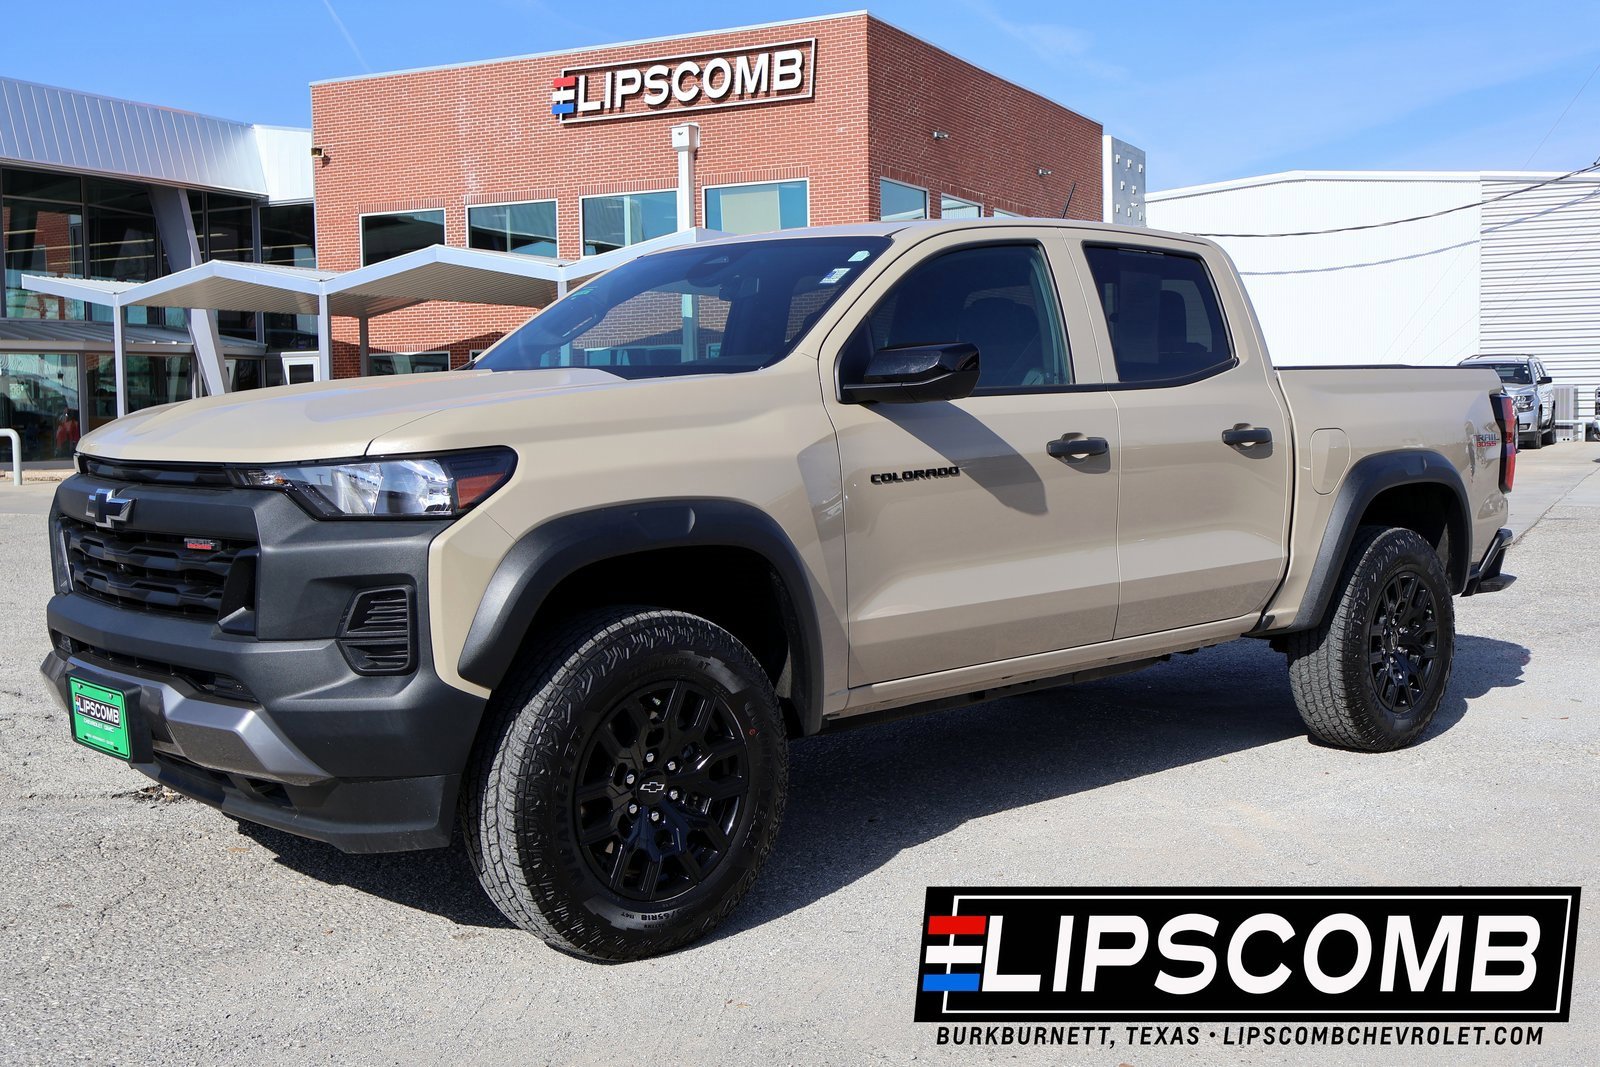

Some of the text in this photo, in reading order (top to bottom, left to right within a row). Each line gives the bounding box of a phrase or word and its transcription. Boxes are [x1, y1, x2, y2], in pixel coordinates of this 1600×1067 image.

[577, 49, 804, 112] LIPSCOMB
[870, 466, 960, 484] COLORADO
[80, 698, 120, 724] LIPSCOMB
